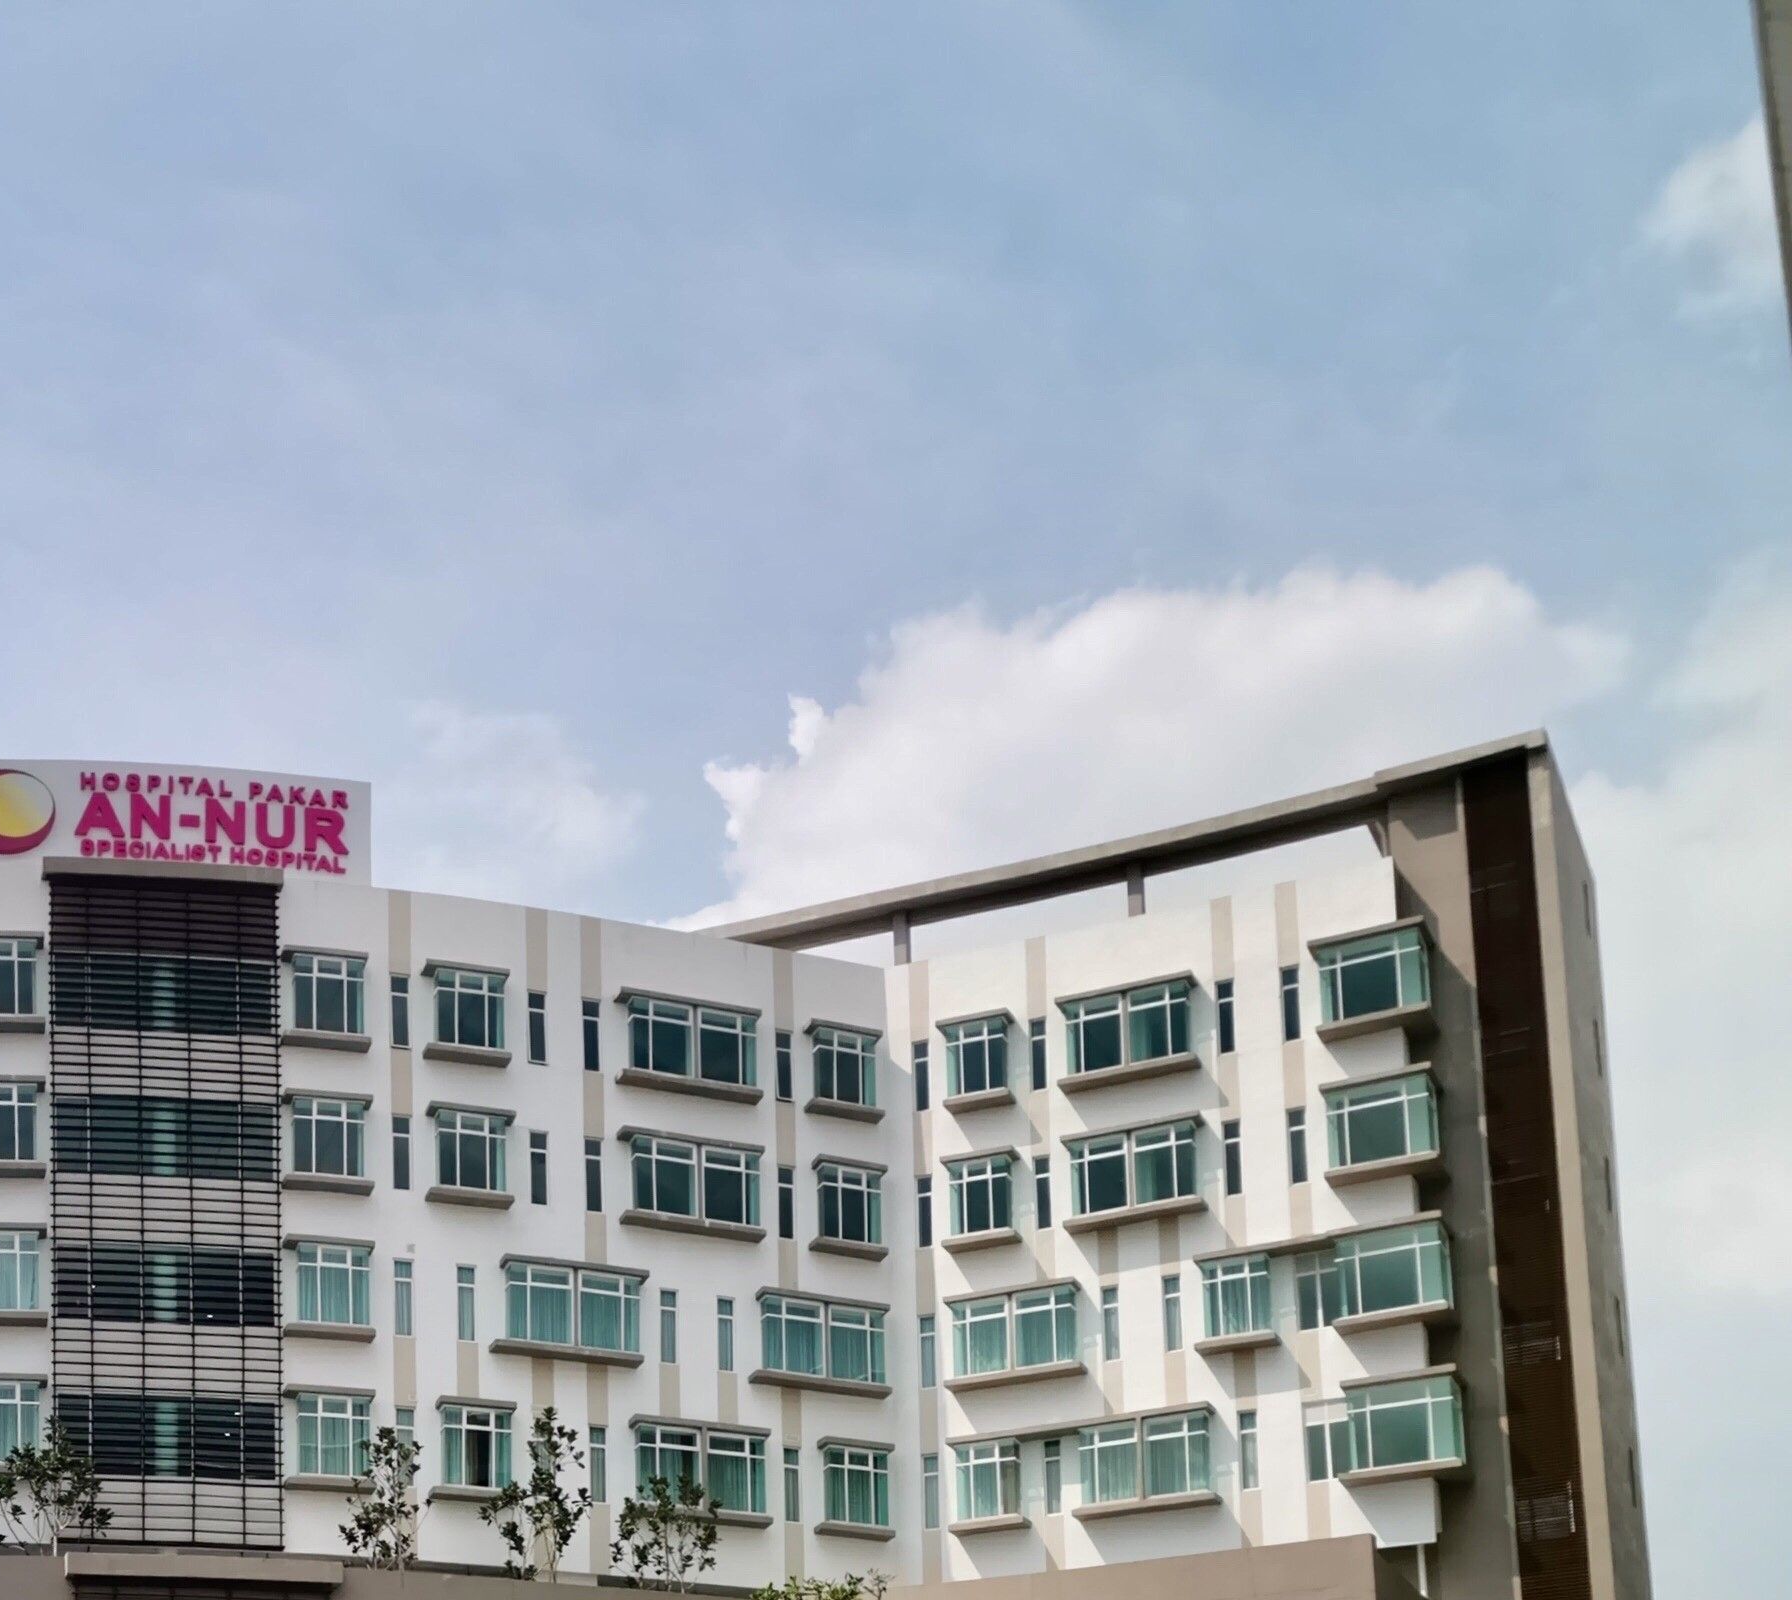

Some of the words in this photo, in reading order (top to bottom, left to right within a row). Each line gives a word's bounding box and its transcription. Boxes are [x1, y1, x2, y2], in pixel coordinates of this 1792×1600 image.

[80, 772, 232, 798] HOSPITAL
[249, 782, 349, 810] PAKAR
[74, 792, 350, 855] AN-NUR
[80, 839, 222, 863] SPECIALIST
[230, 847, 346, 875] HOSPITAL
